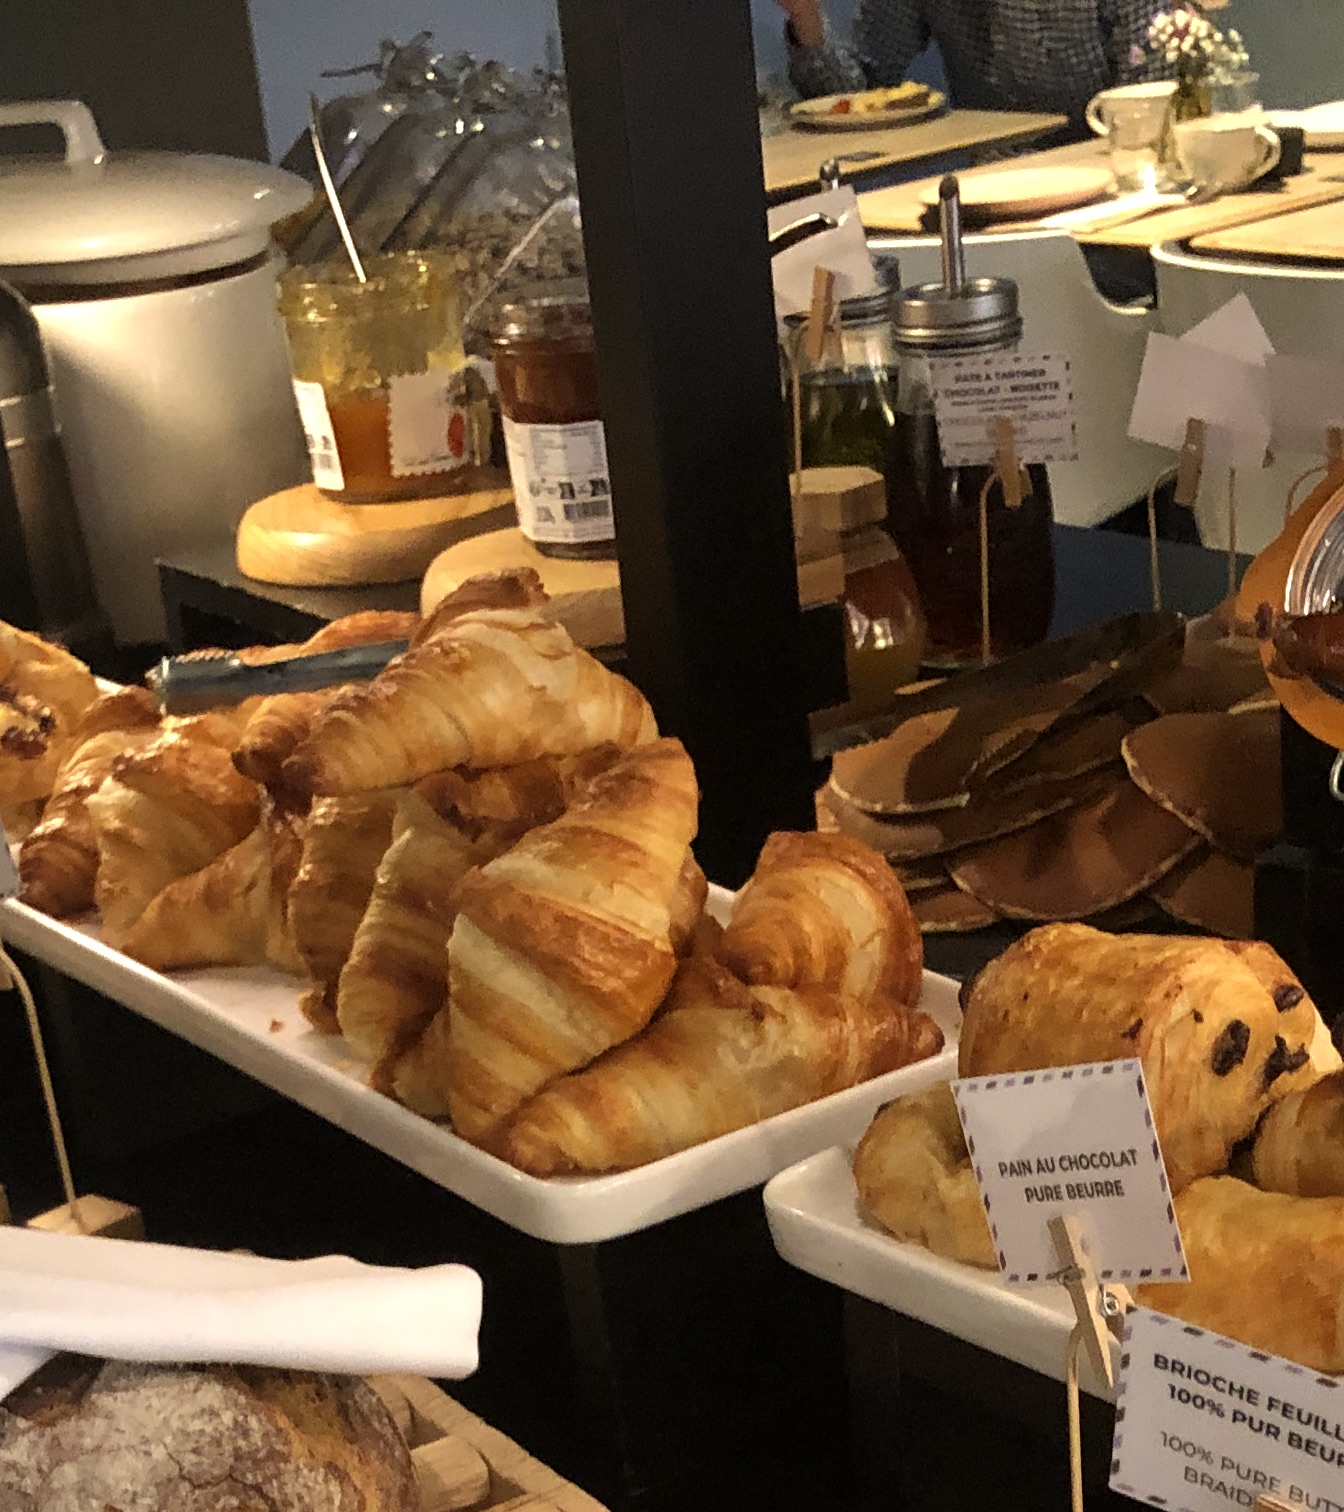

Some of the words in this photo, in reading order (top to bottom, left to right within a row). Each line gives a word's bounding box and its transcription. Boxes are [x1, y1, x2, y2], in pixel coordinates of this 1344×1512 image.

[998, 1159, 1033, 1178] PAIN
[1036, 1156, 1056, 1174] AU
[1058, 1149, 1138, 1173] CHOCOLAT
[1024, 1184, 1064, 1203] PURE
[1065, 1179, 1125, 1201] BEURRE
[1153, 1353, 1261, 1407] BRIOCHE
[1167, 1383, 1226, 1420] 100%
[1231, 1408, 1281, 1442] PUR
[1160, 1430, 1215, 1467] 100%
[1220, 1455, 1281, 1496] PURE
[1183, 1465, 1257, 1509] BRAID
